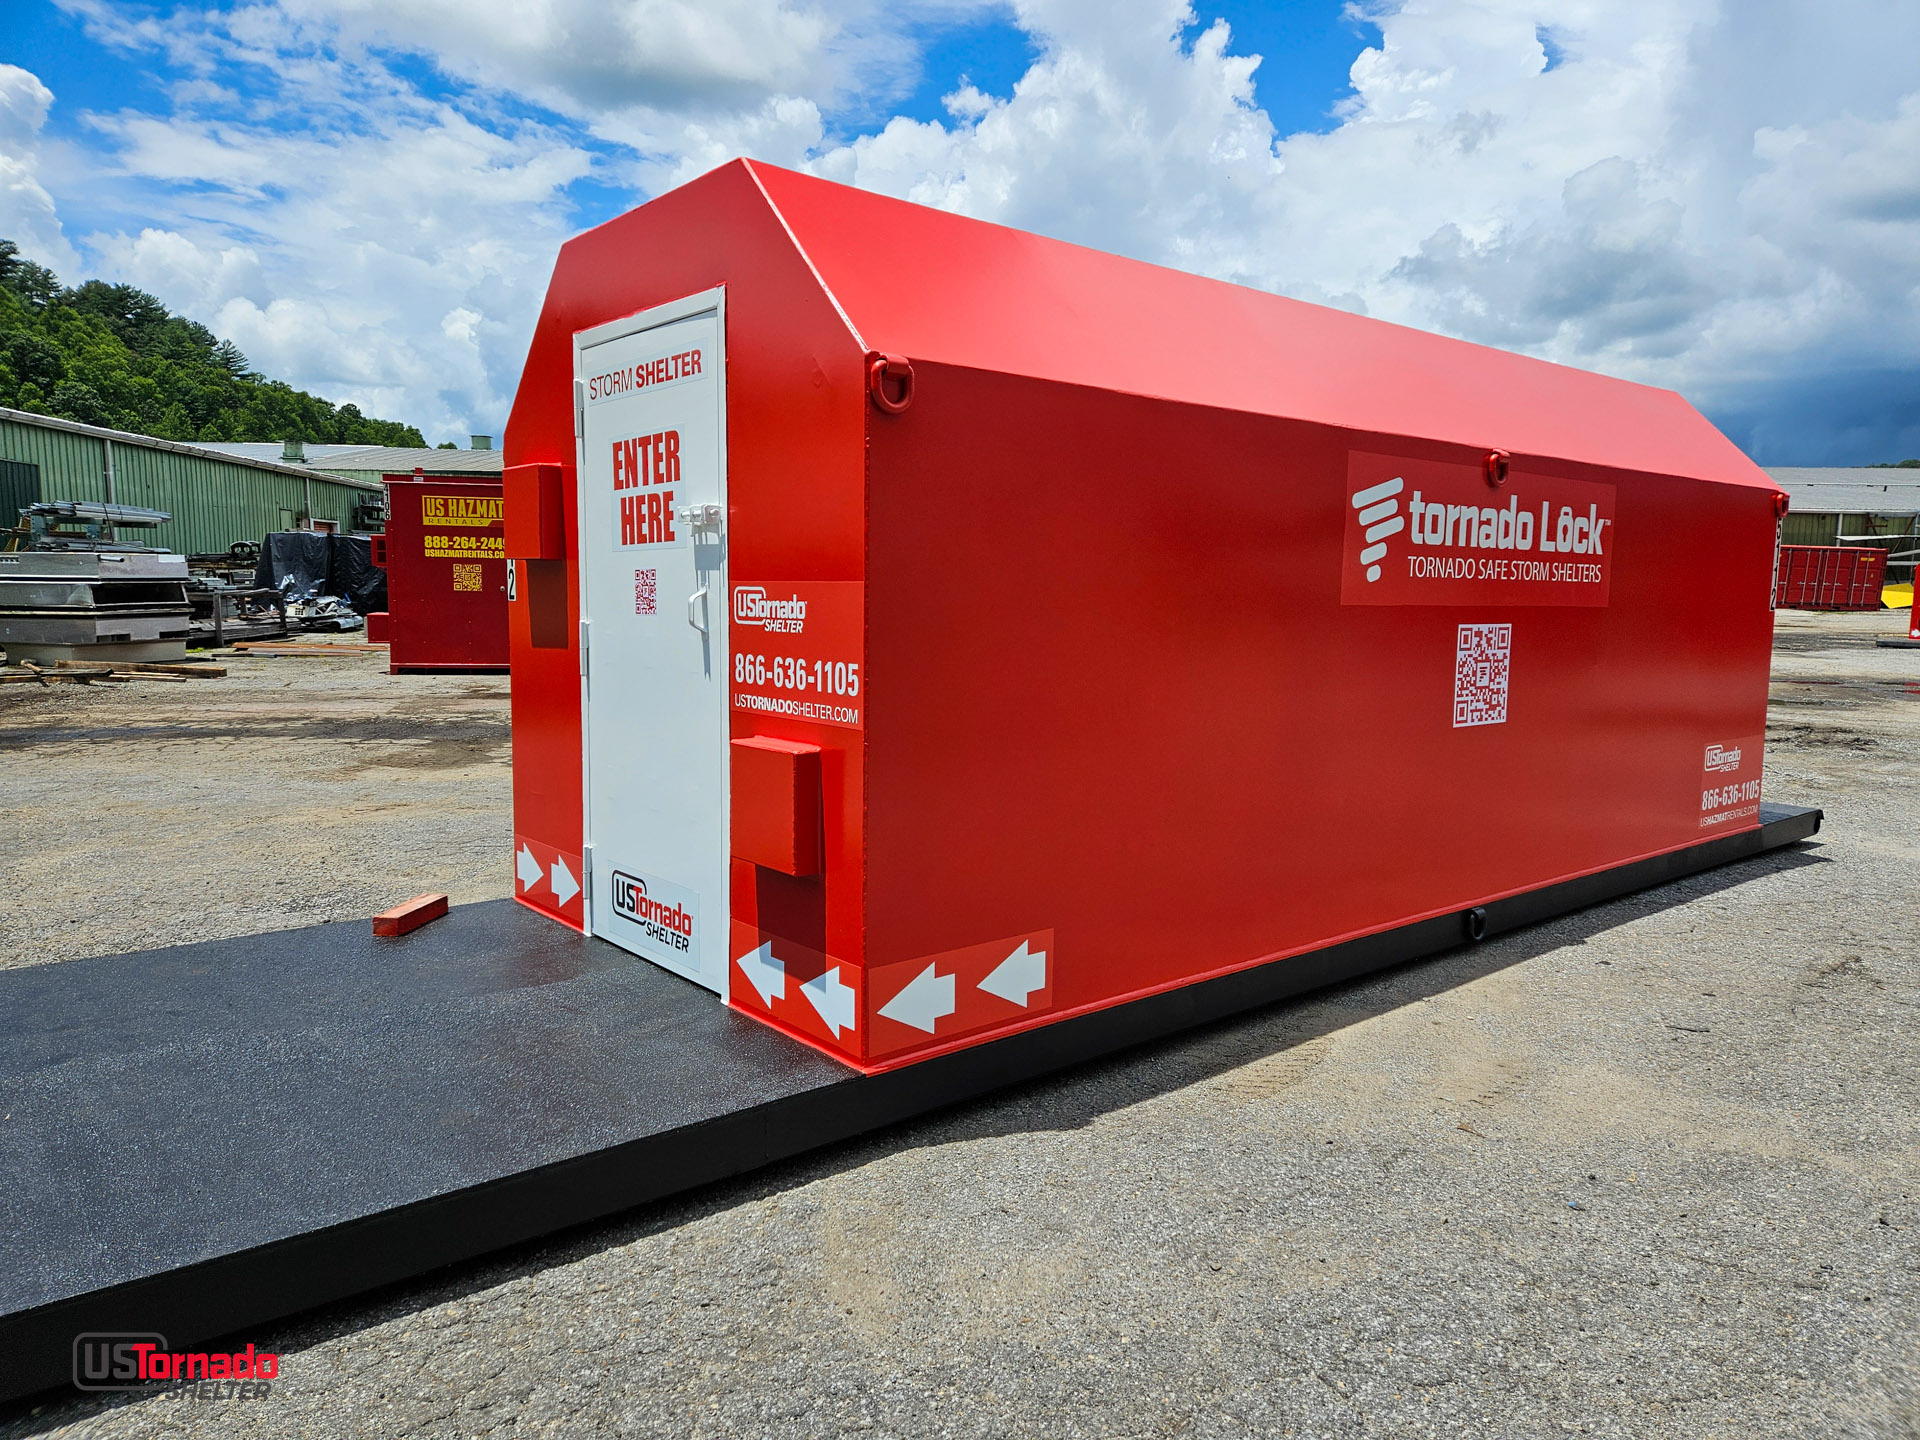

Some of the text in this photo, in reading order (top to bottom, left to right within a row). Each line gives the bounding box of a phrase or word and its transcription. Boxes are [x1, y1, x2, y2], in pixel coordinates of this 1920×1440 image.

[589, 349, 702, 400] STORM SHELTER
[612, 430, 681, 491] ENTER
[426, 498, 504, 518] US HAZMAT
[620, 490, 675, 546] HERE
[1409, 490, 1534, 551] tornado
[1408, 556, 1602, 583] TORNADO SAFE STORM SHELTERS
[764, 619, 804, 633] SHELTER
[735, 653, 859, 697] 866-636-1105
[734, 693, 858, 724] USTORNADOSHELTER.COM
[1719, 762, 1740, 772] SHELTER
[1701, 780, 1760, 811] 866-636-1105
[646, 921, 689, 953] SHELTER
